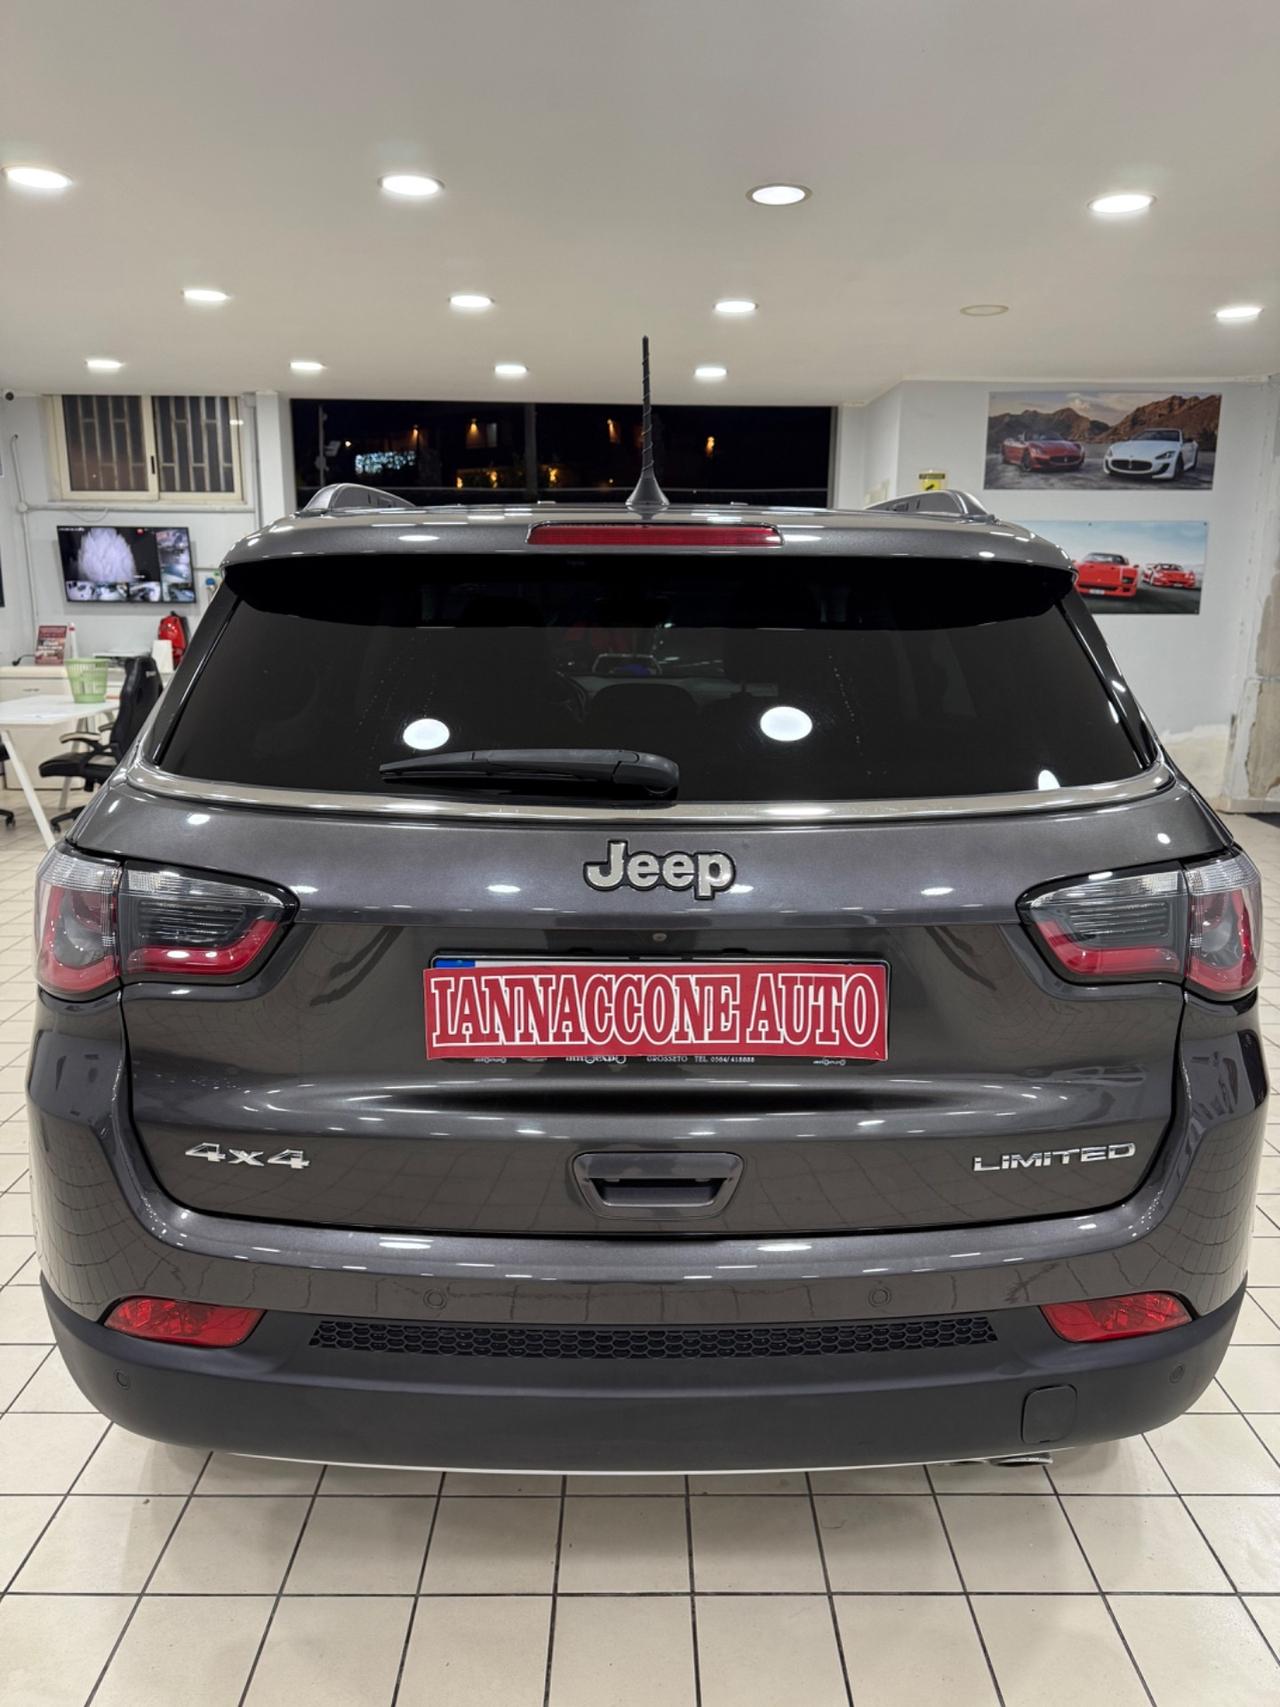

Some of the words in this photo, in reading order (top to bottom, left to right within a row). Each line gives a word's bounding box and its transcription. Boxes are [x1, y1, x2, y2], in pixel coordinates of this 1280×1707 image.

[584, 841, 735, 898] Jeep
[431, 973, 741, 1047] IANNACCONE
[746, 972, 880, 1047] AUTO
[973, 1141, 1136, 1172] LIMITED
